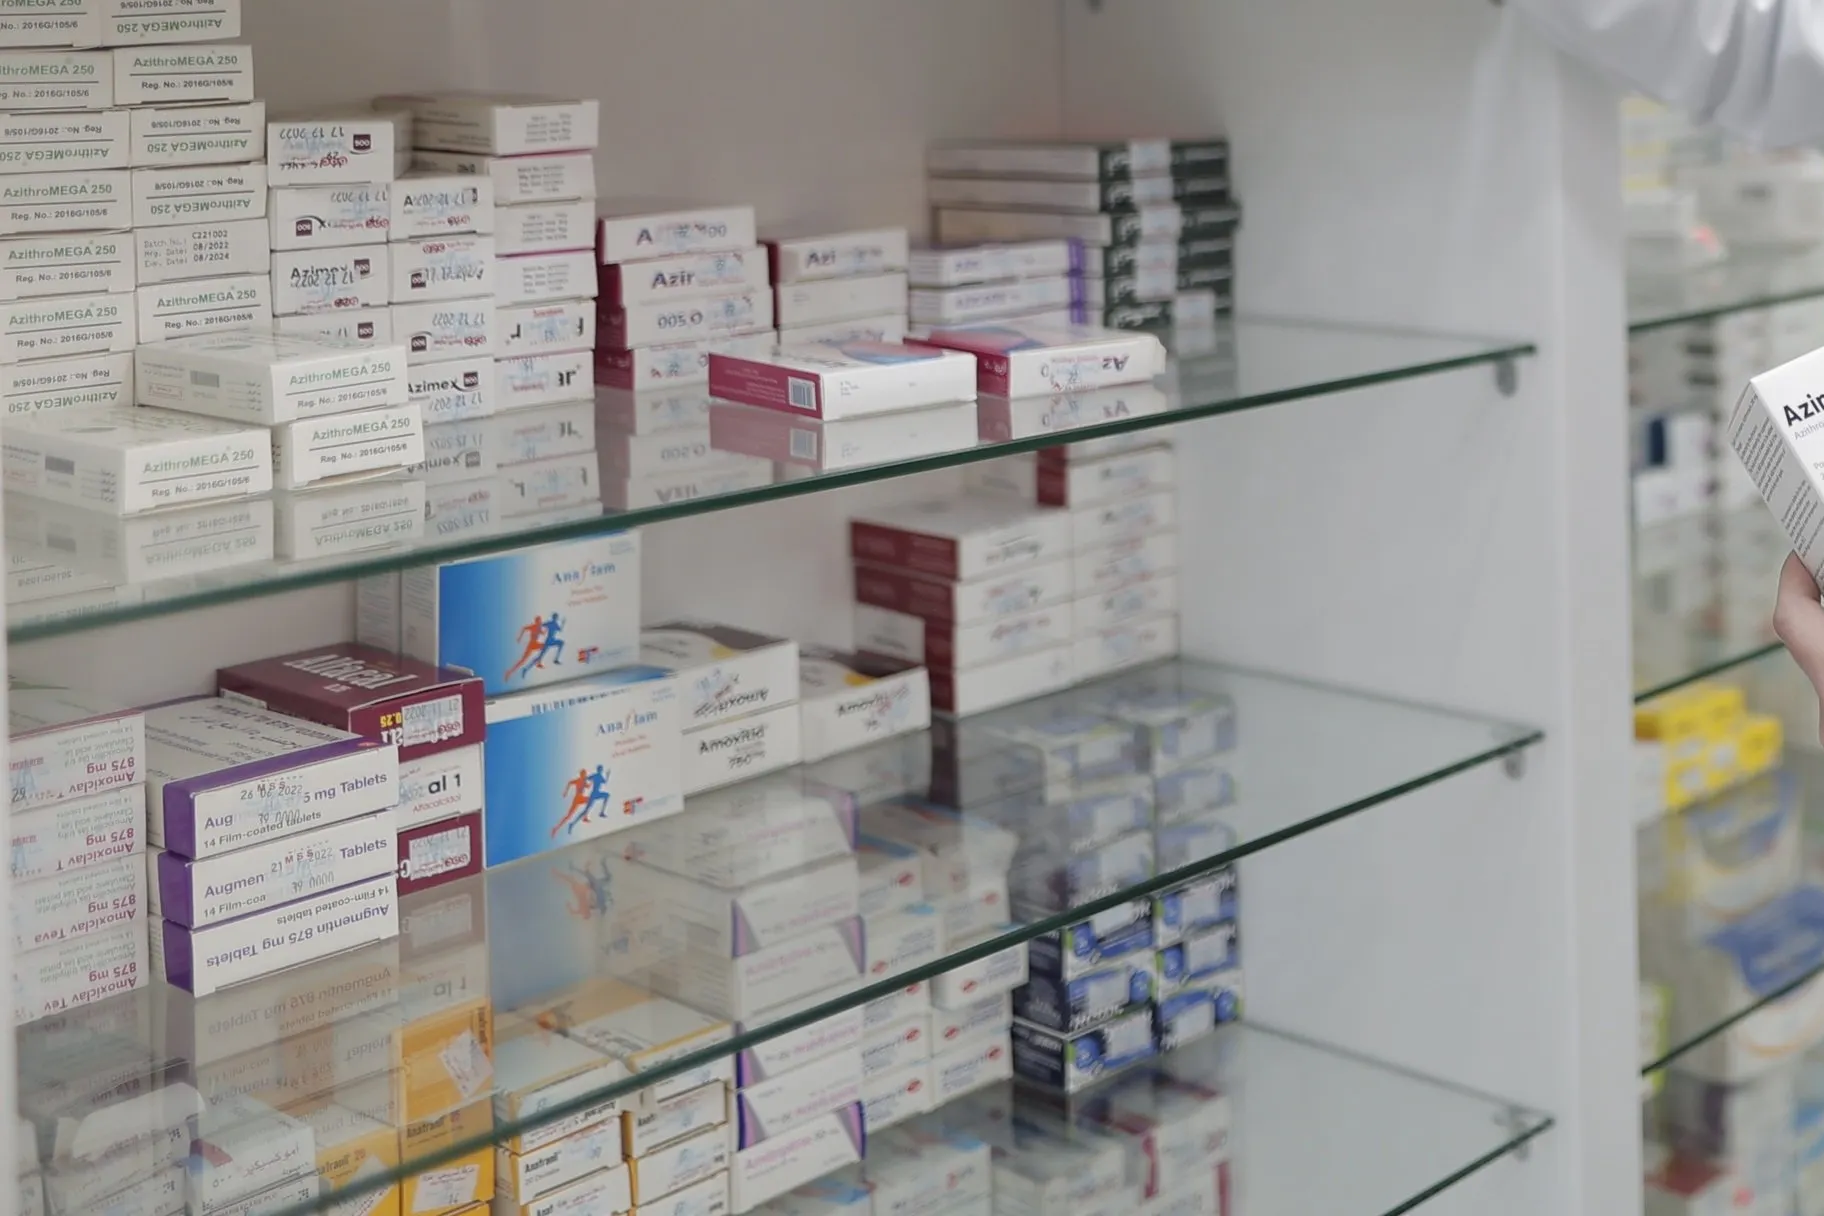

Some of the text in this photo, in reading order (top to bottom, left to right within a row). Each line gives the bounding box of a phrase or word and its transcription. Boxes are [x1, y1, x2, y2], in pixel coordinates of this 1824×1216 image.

[117, 19, 223, 33] AzithroMEGA 250
[0, 65, 94, 76] ithroMEGA 250
[134, 55, 238, 67] AzithroMEGA 250
[0, 147, 109, 162] AzithroMEGA 250
[147, 139, 248, 154] AzithroMEGA 250
[4, 184, 112, 198] AzithroMEGA 250
[150, 199, 251, 215] AzithroMEGA 250
[192, 229, 228, 240] C221002
[8, 244, 116, 261] AzithroMEGA 250
[193, 241, 229, 251] 08/2022
[193, 252, 230, 263] 08/2024
[652, 270, 695, 289] Azir
[157, 290, 257, 309] AzithroMEGA 250
[9, 306, 118, 326] AzithroMEGA 250
[289, 361, 391, 386] AzithroMEGA 250
[8, 390, 118, 414] AzithroMEGA 250
[312, 417, 411, 442] AzithroMEGA 250
[143, 448, 254, 474] AzithroMEGA 250
[87, 756, 135, 775] 875 mg
[69, 770, 136, 793] Amoxiclav
[314, 772, 388, 801] mg Tablets
[86, 827, 135, 847] 875 mg
[68, 842, 135, 866] Amoxiclav
[204, 837, 388, 899] Augmen Tablets
[88, 893, 137, 914] 875 mg
[204, 893, 267, 920] 14 Film-coa
[277, 885, 390, 926] 14 Film-coated tablets
[35, 908, 137, 944] Amoxiclav Teva
[206, 903, 390, 968] Augmentin 875 mg Tablets
[89, 961, 137, 982] 875 mg
